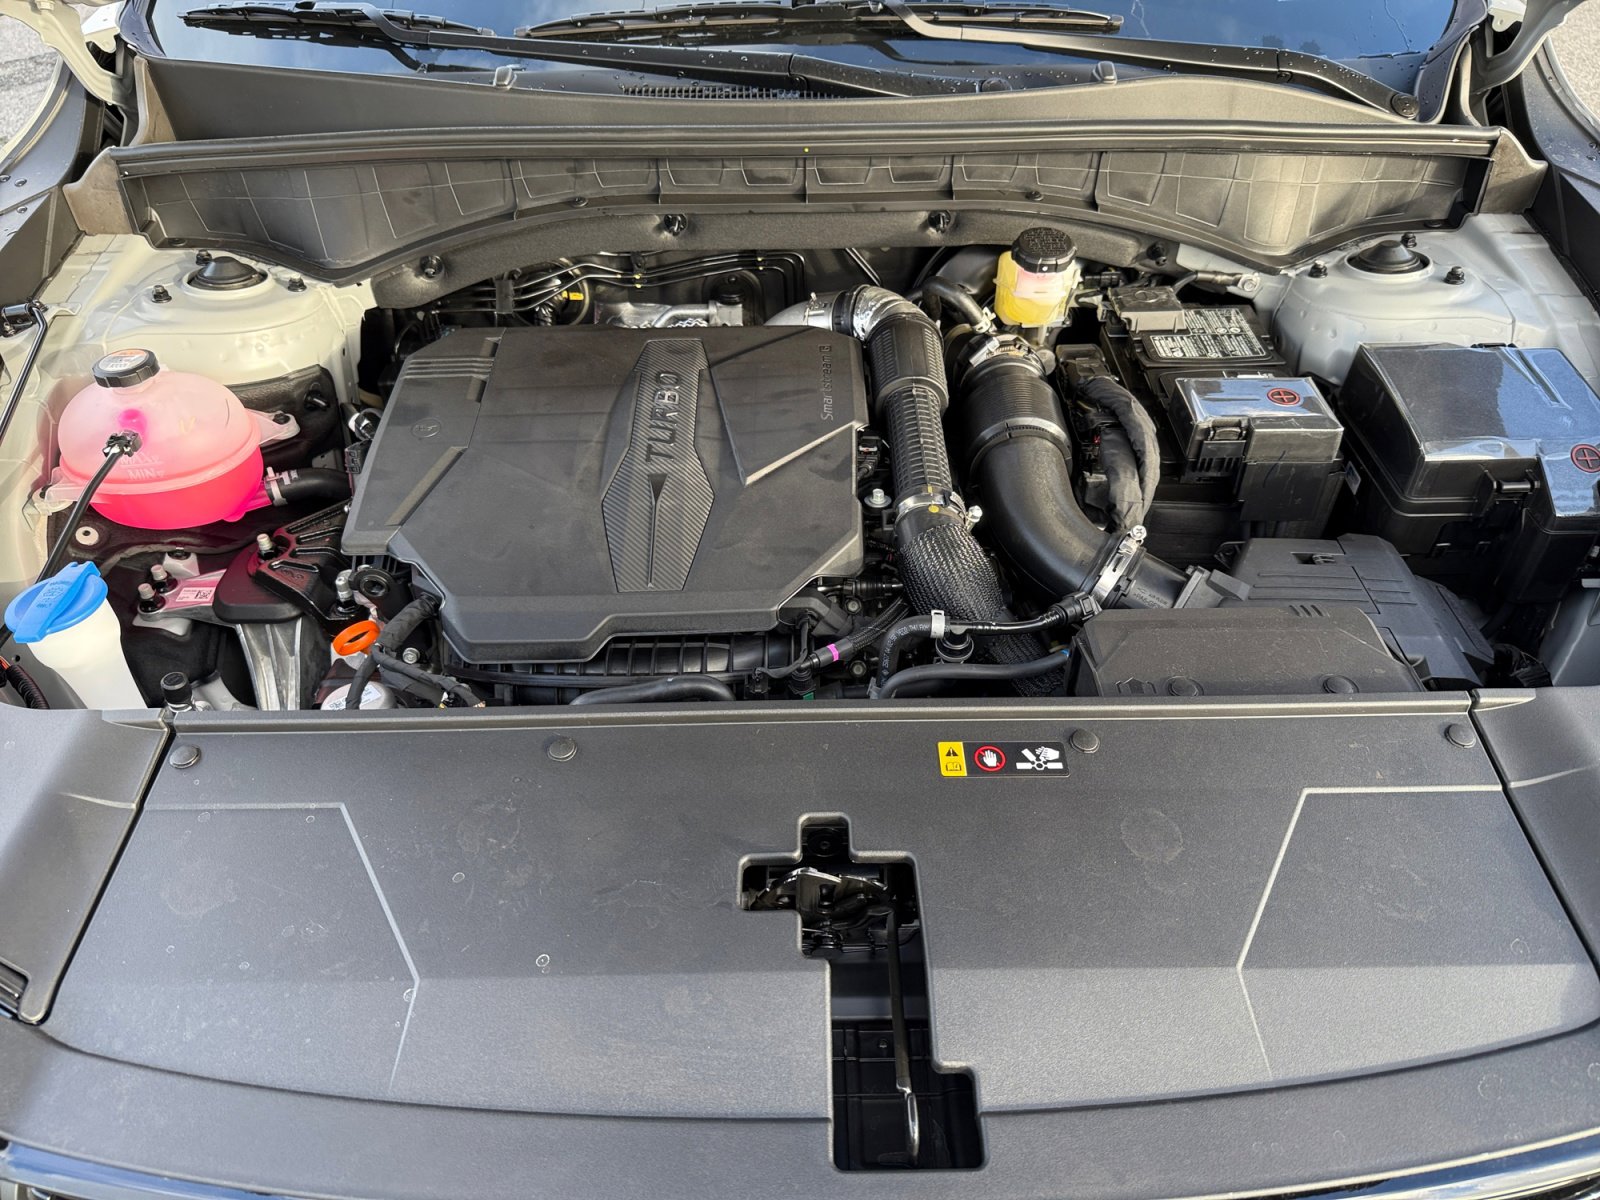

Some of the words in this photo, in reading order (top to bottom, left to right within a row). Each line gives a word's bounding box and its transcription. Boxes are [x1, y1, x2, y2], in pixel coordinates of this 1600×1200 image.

[819, 344, 832, 353] G
[821, 354, 834, 421] Smartstream
[645, 371, 681, 463] TURBO
[120, 452, 154, 465] MAX
[128, 468, 155, 480] MIN
